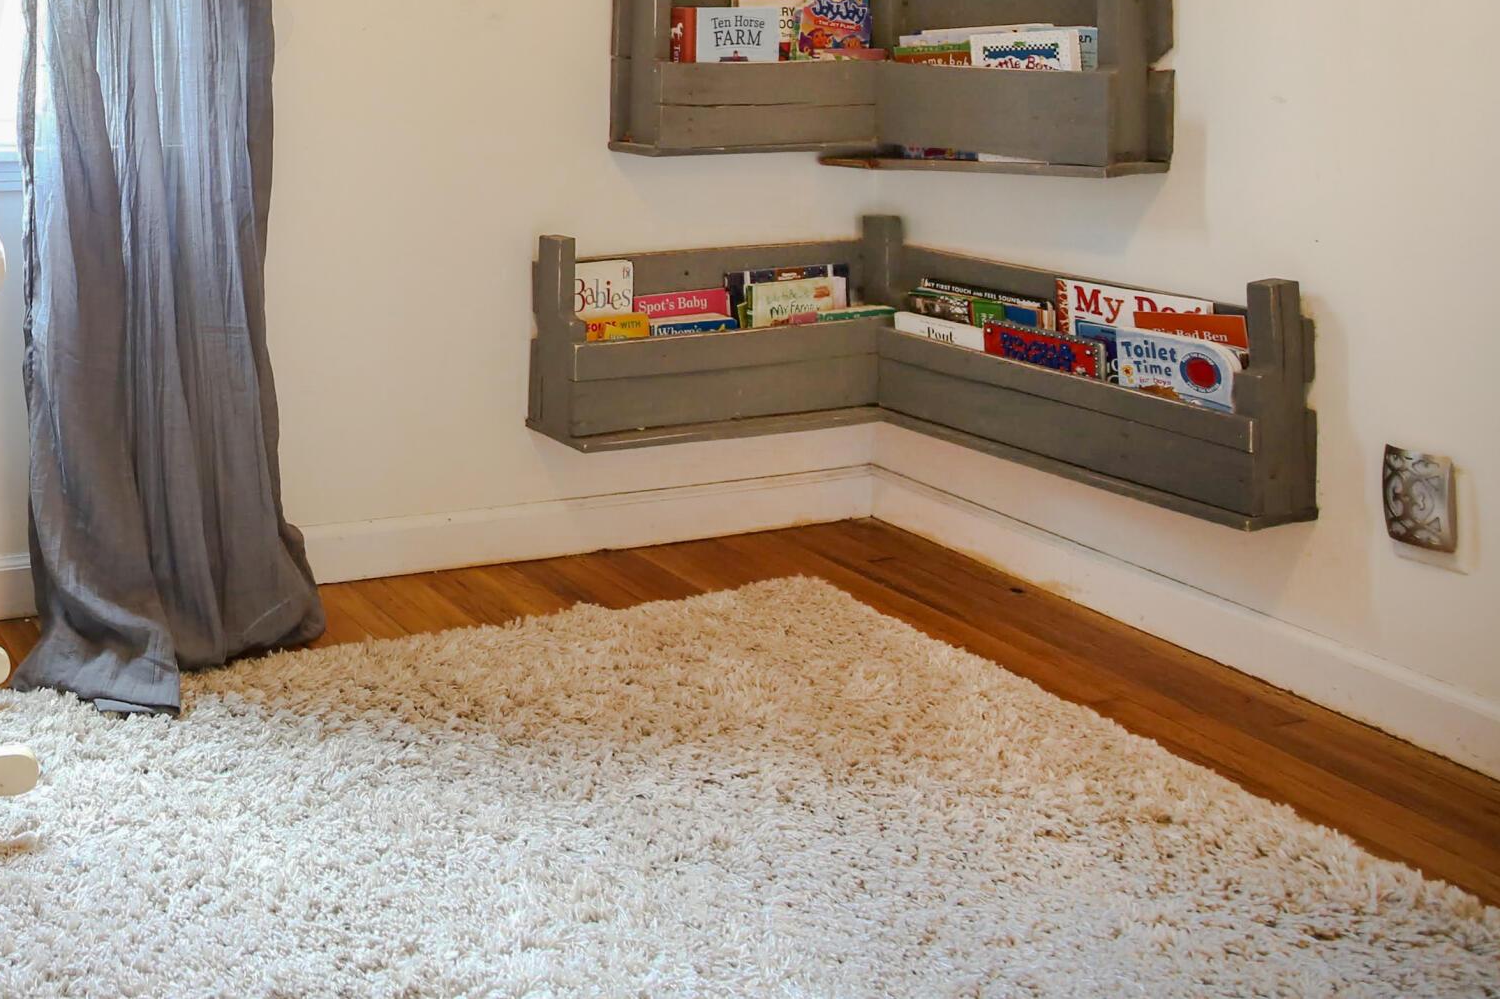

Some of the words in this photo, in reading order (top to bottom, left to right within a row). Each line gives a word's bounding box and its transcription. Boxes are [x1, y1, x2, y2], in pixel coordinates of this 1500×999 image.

[711, 17, 732, 30] Ten
[734, 15, 765, 29] Horse
[713, 28, 763, 48] FARM
[574, 278, 632, 312] Babies
[936, 282, 951, 291] FIRST
[951, 285, 972, 295] TOUCH
[984, 291, 997, 300] FEEL
[638, 298, 675, 315] Spot's
[677, 296, 708, 311] Baby
[1073, 285, 1125, 324] My
[620, 320, 641, 330] WITH
[1202, 330, 1229, 342] Ben
[1120, 340, 1177, 363] Toilet
[1133, 360, 1173, 377] Time
